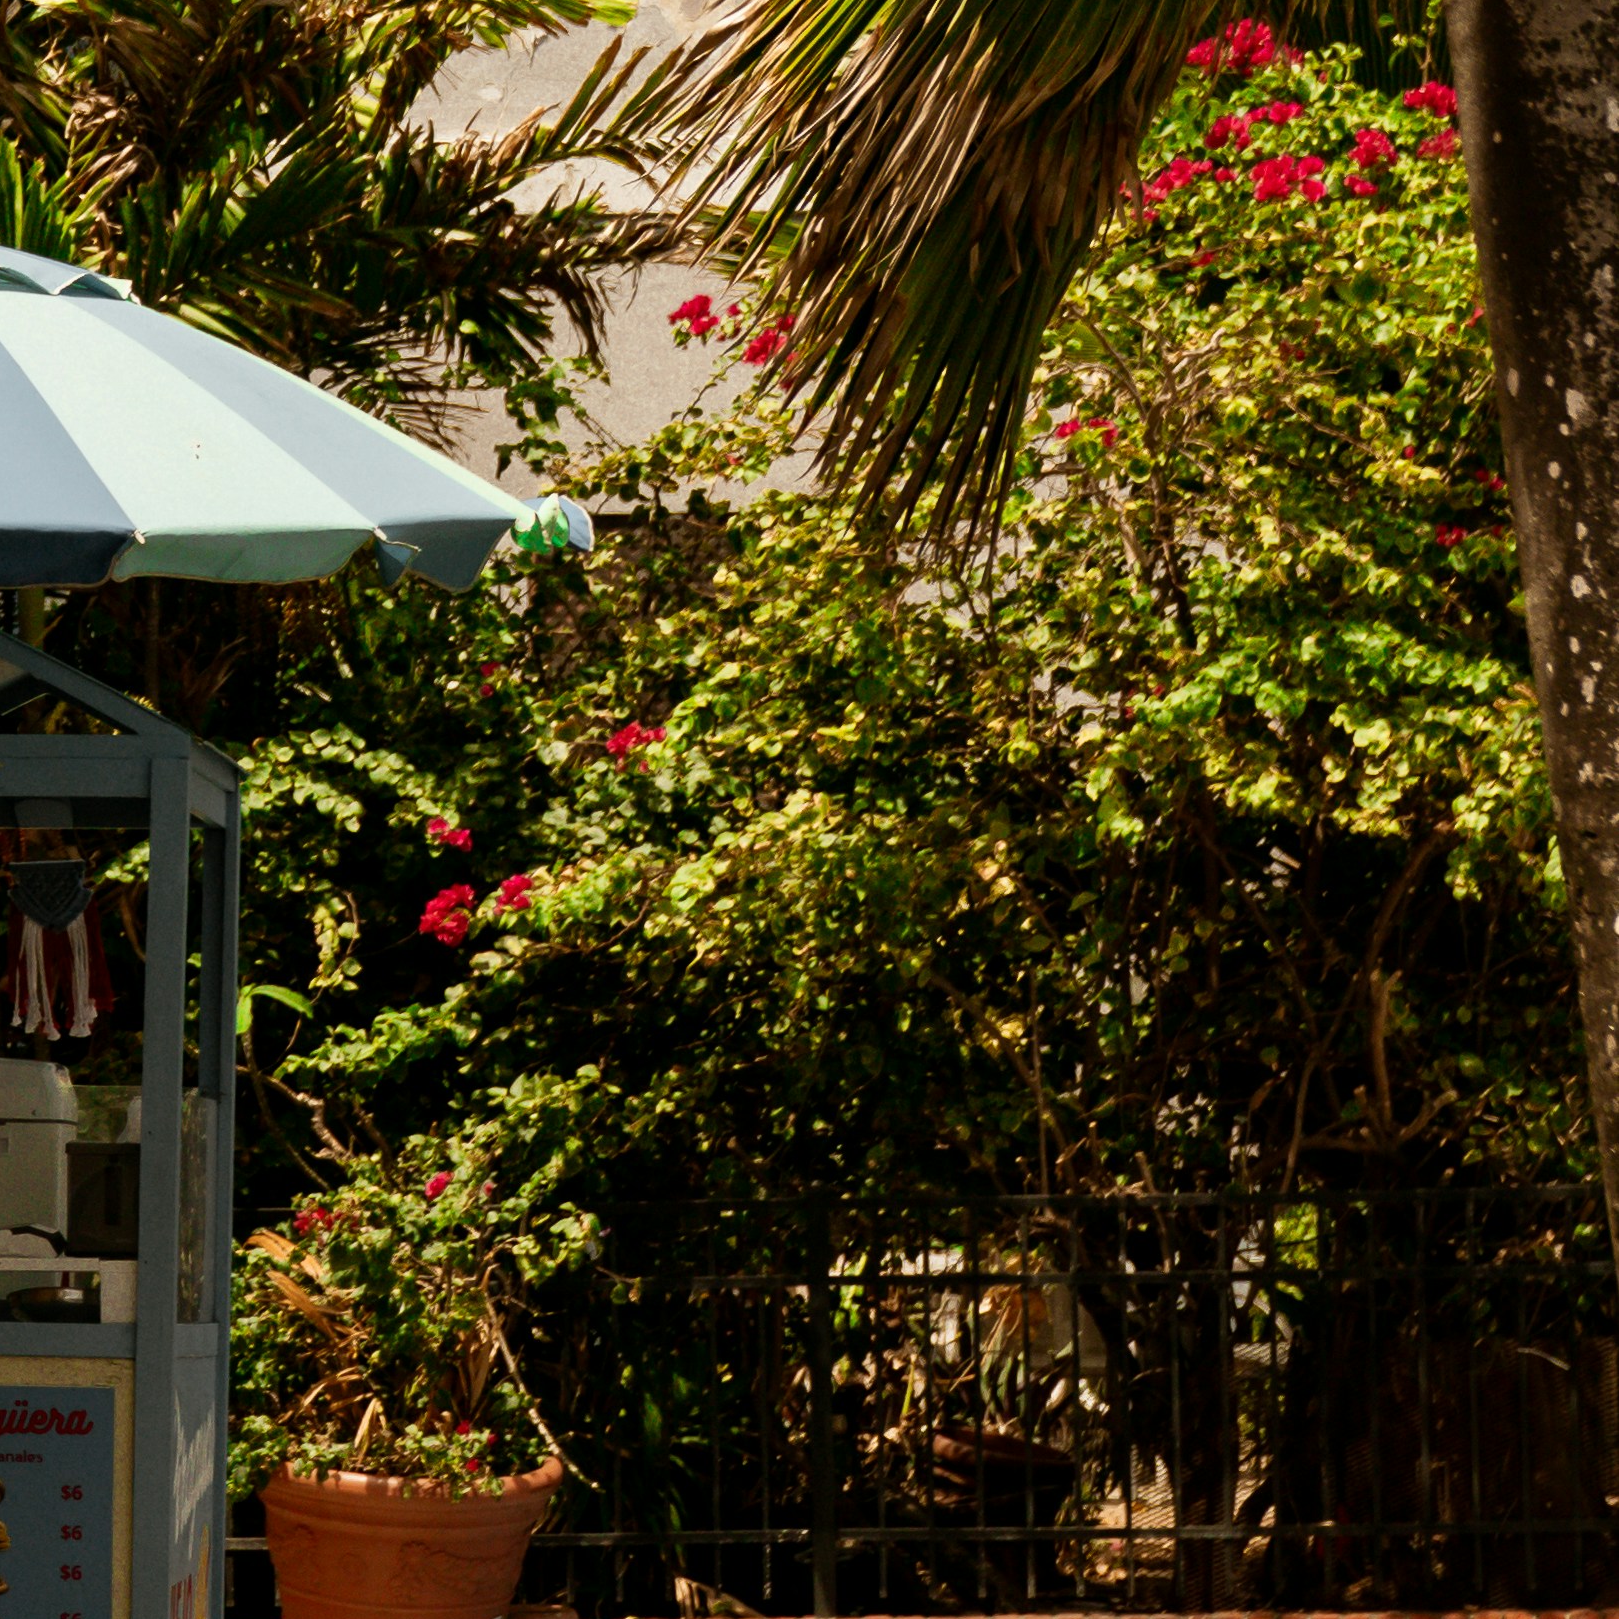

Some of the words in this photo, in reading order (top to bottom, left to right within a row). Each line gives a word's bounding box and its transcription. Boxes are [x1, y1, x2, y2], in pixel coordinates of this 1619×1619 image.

[62, 1486, 82, 1500] $6
[62, 1526, 82, 1540] $6
[61, 1566, 83, 1580] $6
